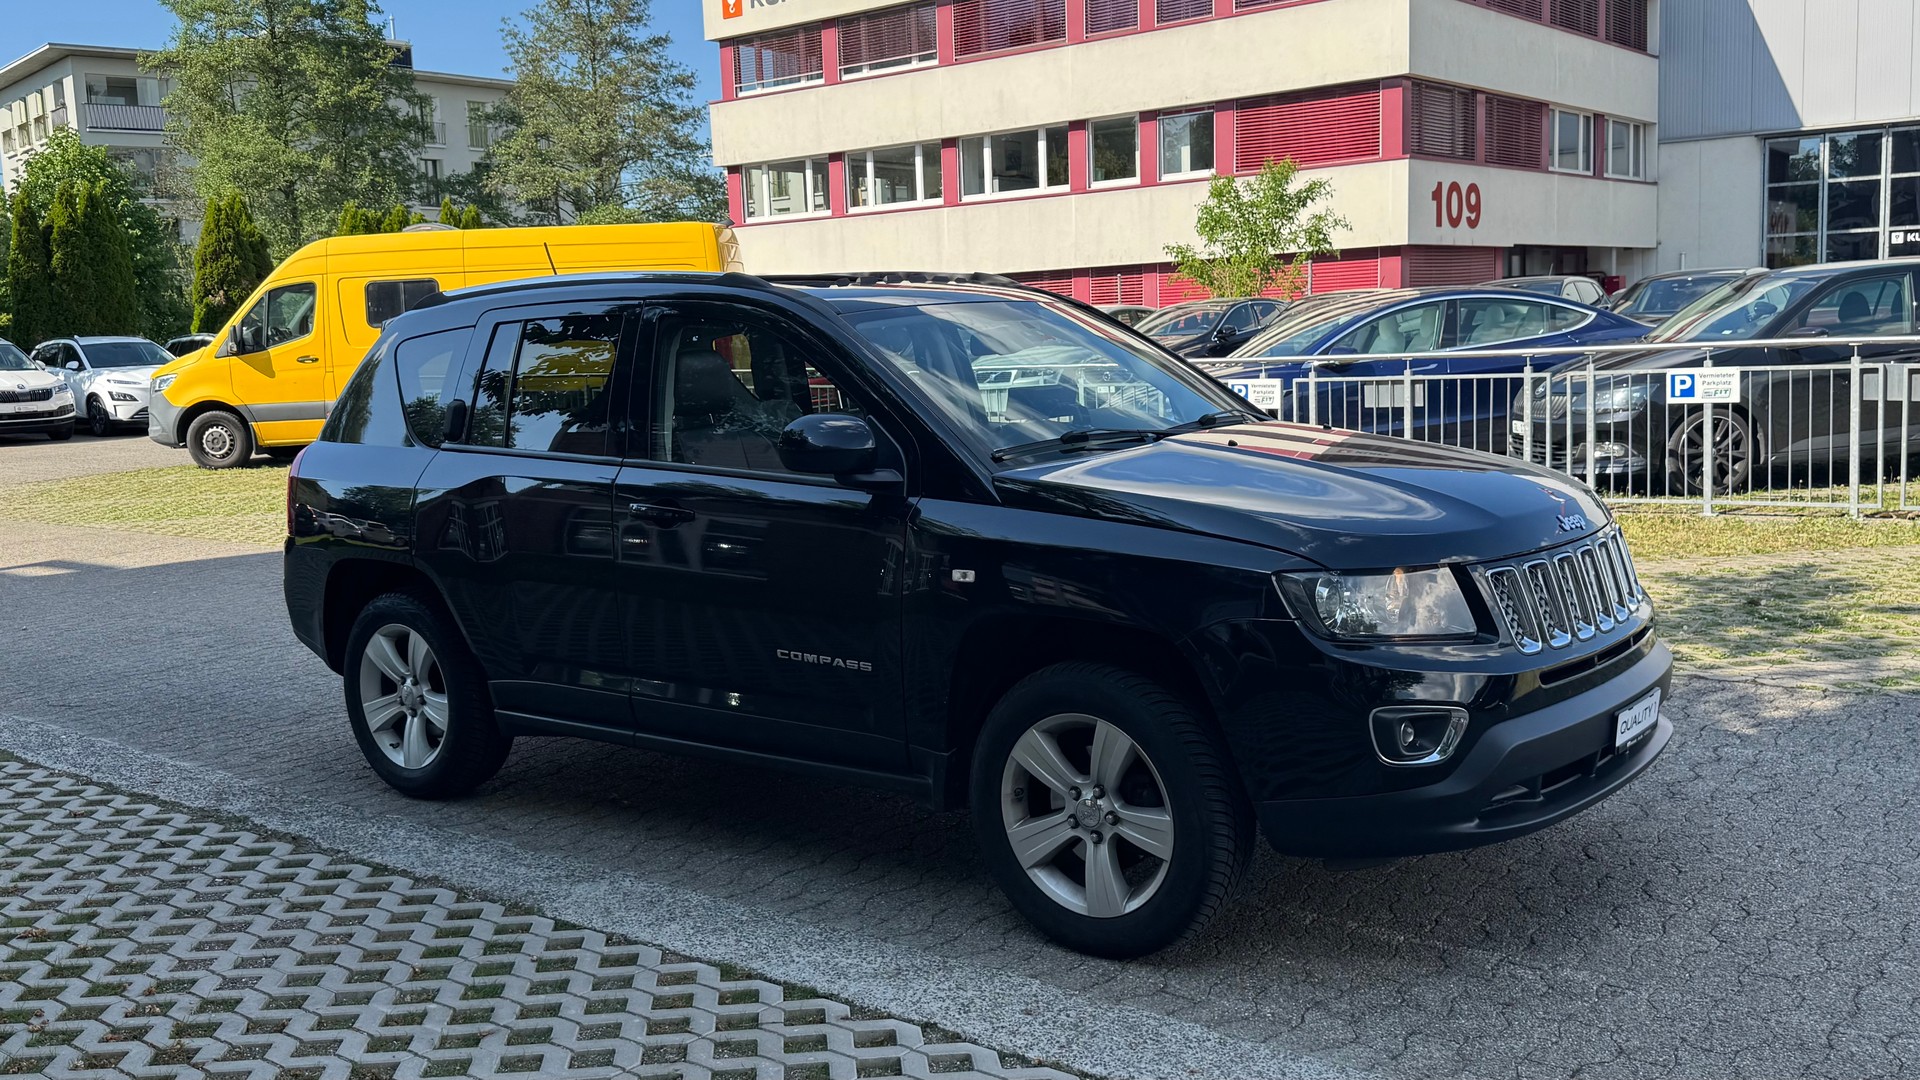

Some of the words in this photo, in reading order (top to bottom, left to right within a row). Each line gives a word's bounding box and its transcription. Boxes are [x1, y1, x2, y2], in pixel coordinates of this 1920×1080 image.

[1431, 181, 1481, 230] 109
[1674, 375, 1692, 397] P
[1713, 389, 1729, 397] FIT
[1557, 514, 1586, 531] Jeep
[776, 649, 872, 672] COMPASS
[1620, 702, 1653, 735] QUALITY
